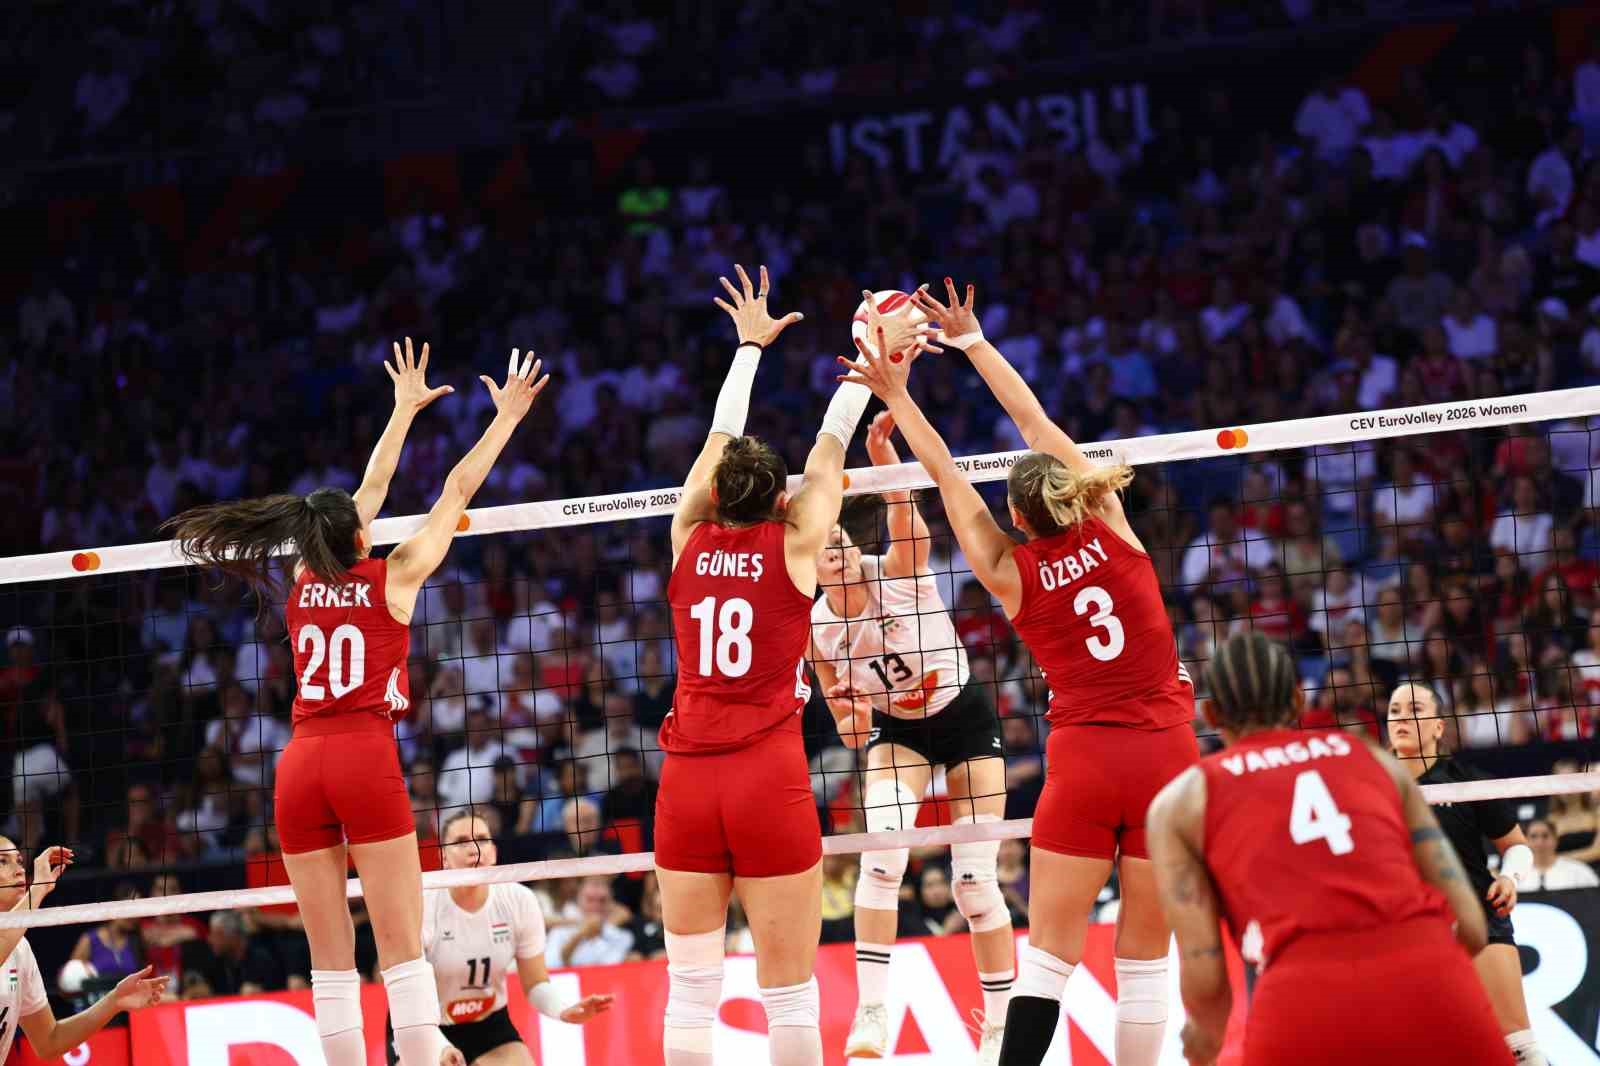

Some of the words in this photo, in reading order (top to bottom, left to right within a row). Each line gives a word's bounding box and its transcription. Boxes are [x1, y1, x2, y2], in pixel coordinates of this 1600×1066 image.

[1350, 417, 1375, 431] CEV
[1379, 411, 1443, 427] EuroVolley
[1446, 407, 1477, 421] 2026
[1479, 403, 1527, 417] Women
[563, 503, 586, 516] CEV
[589, 497, 647, 513] EuroVolley
[650, 493, 677, 506] 2026
[695, 549, 764, 582] GÜNEŞ
[1038, 537, 1109, 592] ÖZBAY
[299, 582, 372, 608] ERKEK
[690, 596, 753, 678] 18
[1073, 586, 1125, 662] 3
[297, 624, 365, 700] 20
[869, 653, 912, 690] 13
[1220, 733, 1351, 776] VARGAS
[1289, 769, 1355, 856] 4
[466, 956, 491, 986] 11
[452, 1001, 484, 1016] MOL
